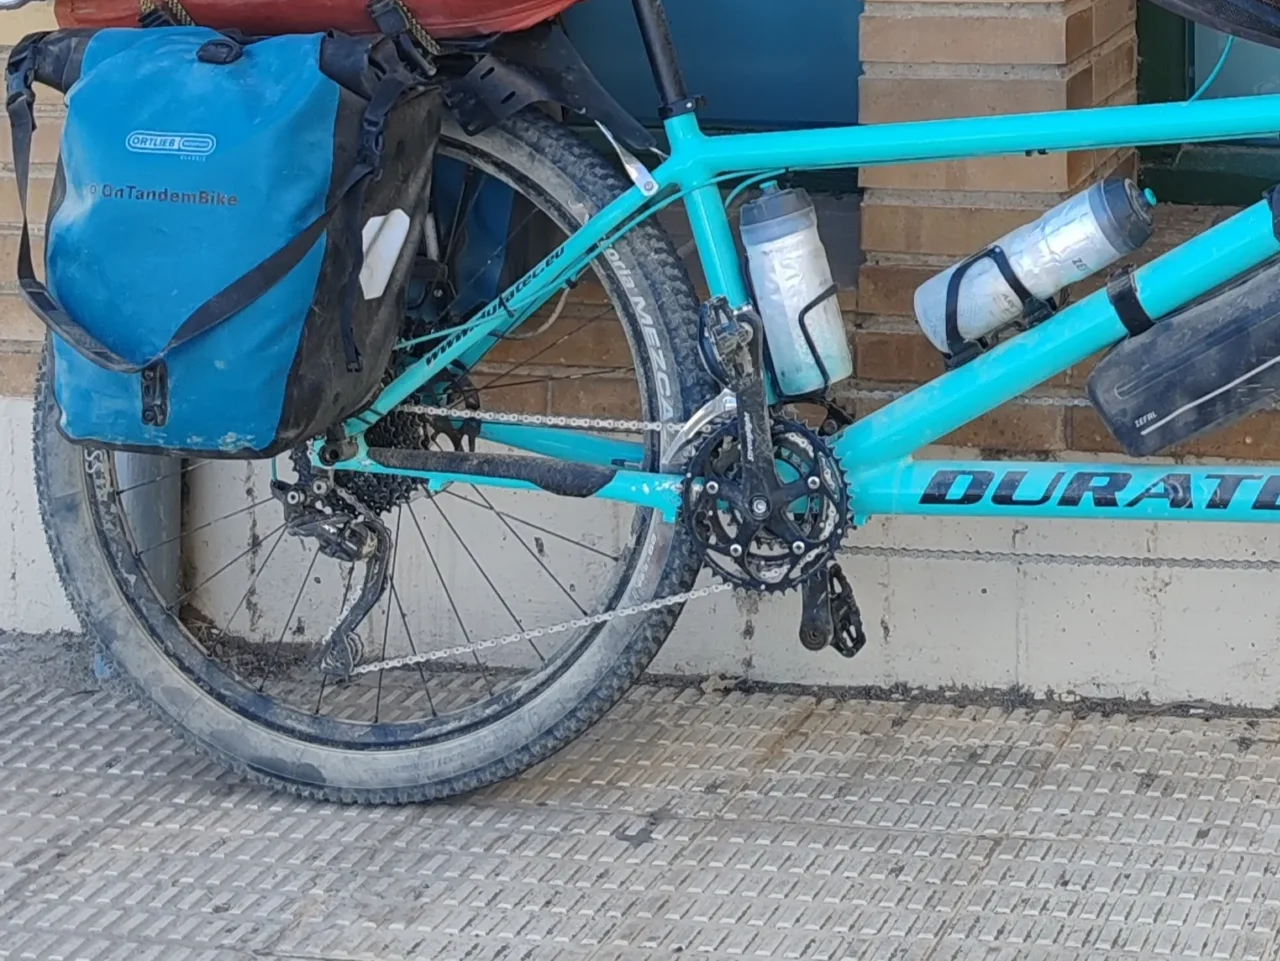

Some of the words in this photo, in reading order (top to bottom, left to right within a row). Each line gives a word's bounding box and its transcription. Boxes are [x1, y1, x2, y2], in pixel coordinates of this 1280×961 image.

[131, 135, 176, 149] ORTLIEB
[101, 184, 238, 206] OnTandemBike
[630, 296, 674, 421] MEZCA
